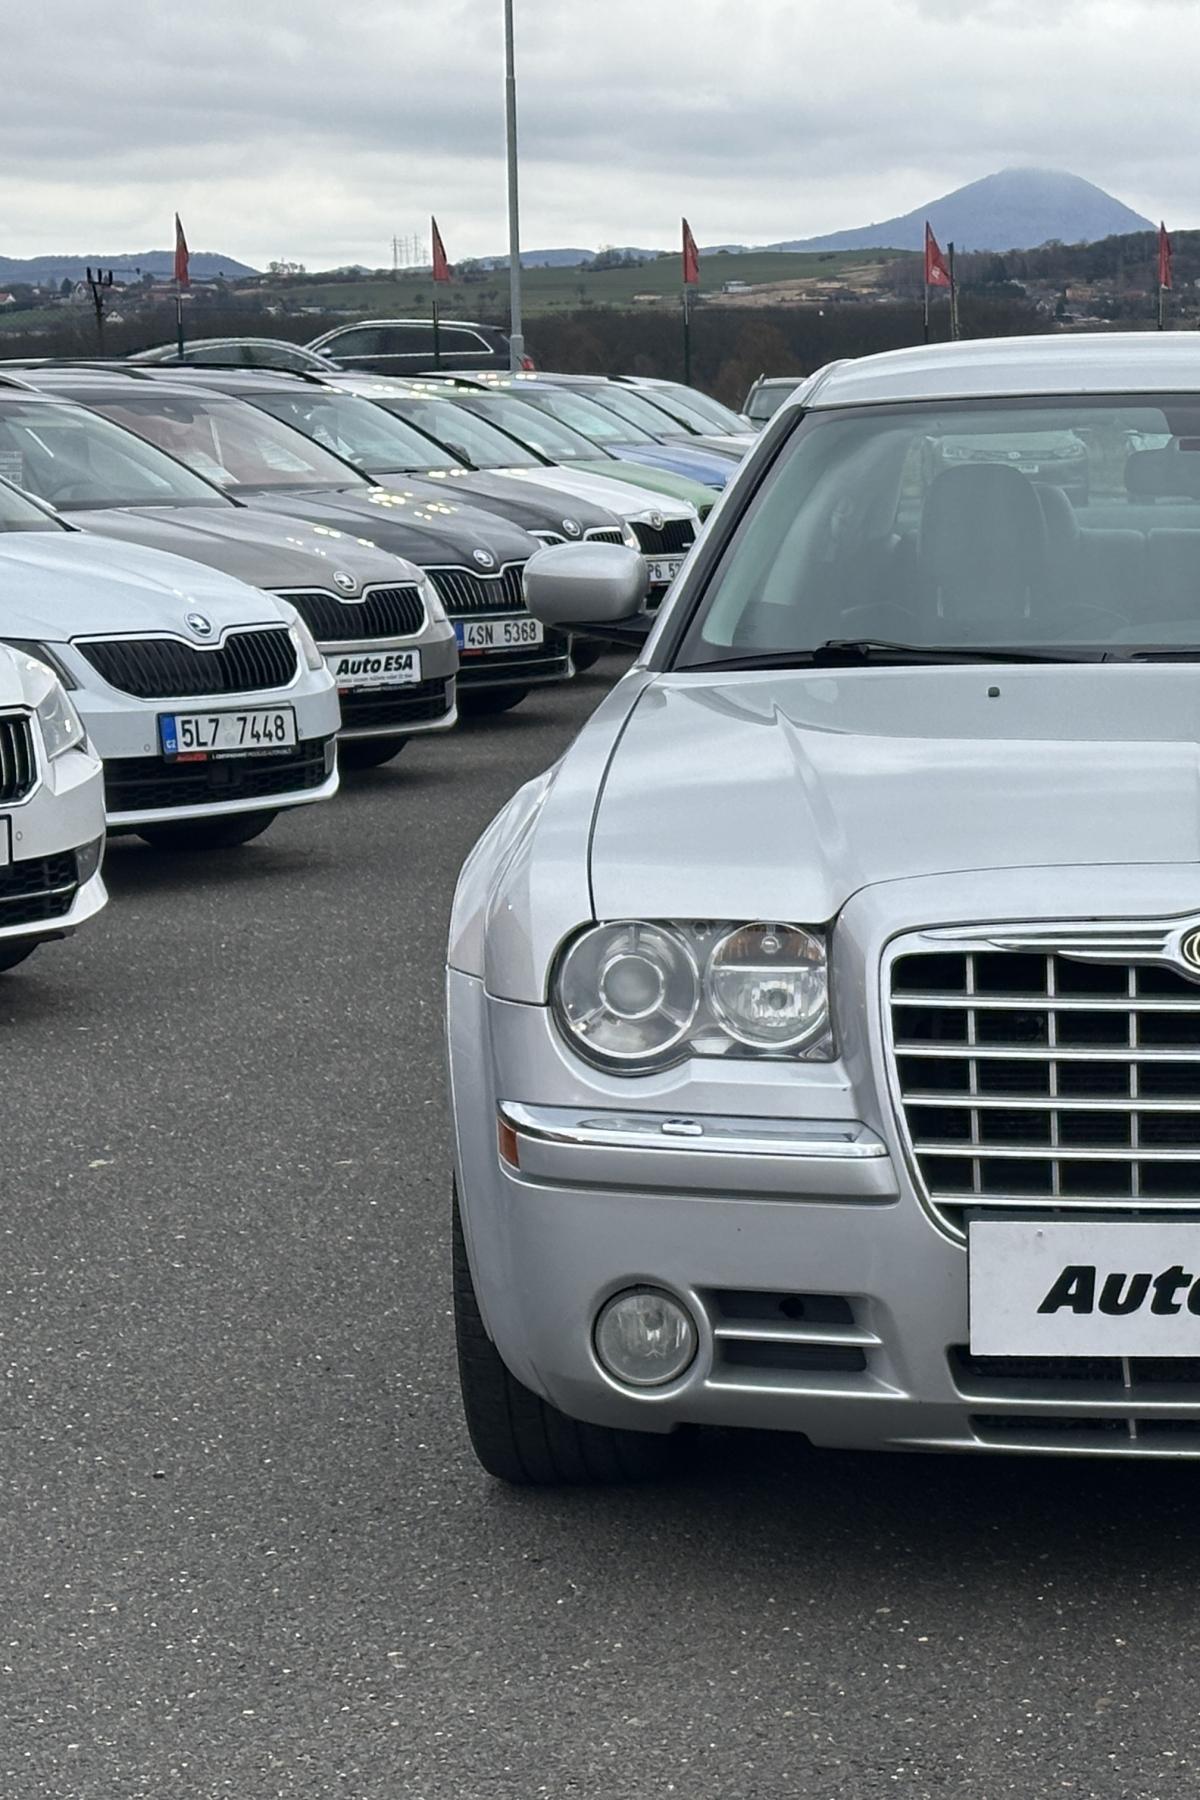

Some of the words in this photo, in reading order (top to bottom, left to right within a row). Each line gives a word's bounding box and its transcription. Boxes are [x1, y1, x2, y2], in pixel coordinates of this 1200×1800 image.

[467, 624, 494, 646] 4SN
[503, 621, 537, 643] 5368
[336, 657, 382, 676] Auto
[383, 654, 413, 672] ESA
[181, 718, 220, 748] 5L7
[236, 714, 286, 745] 7448
